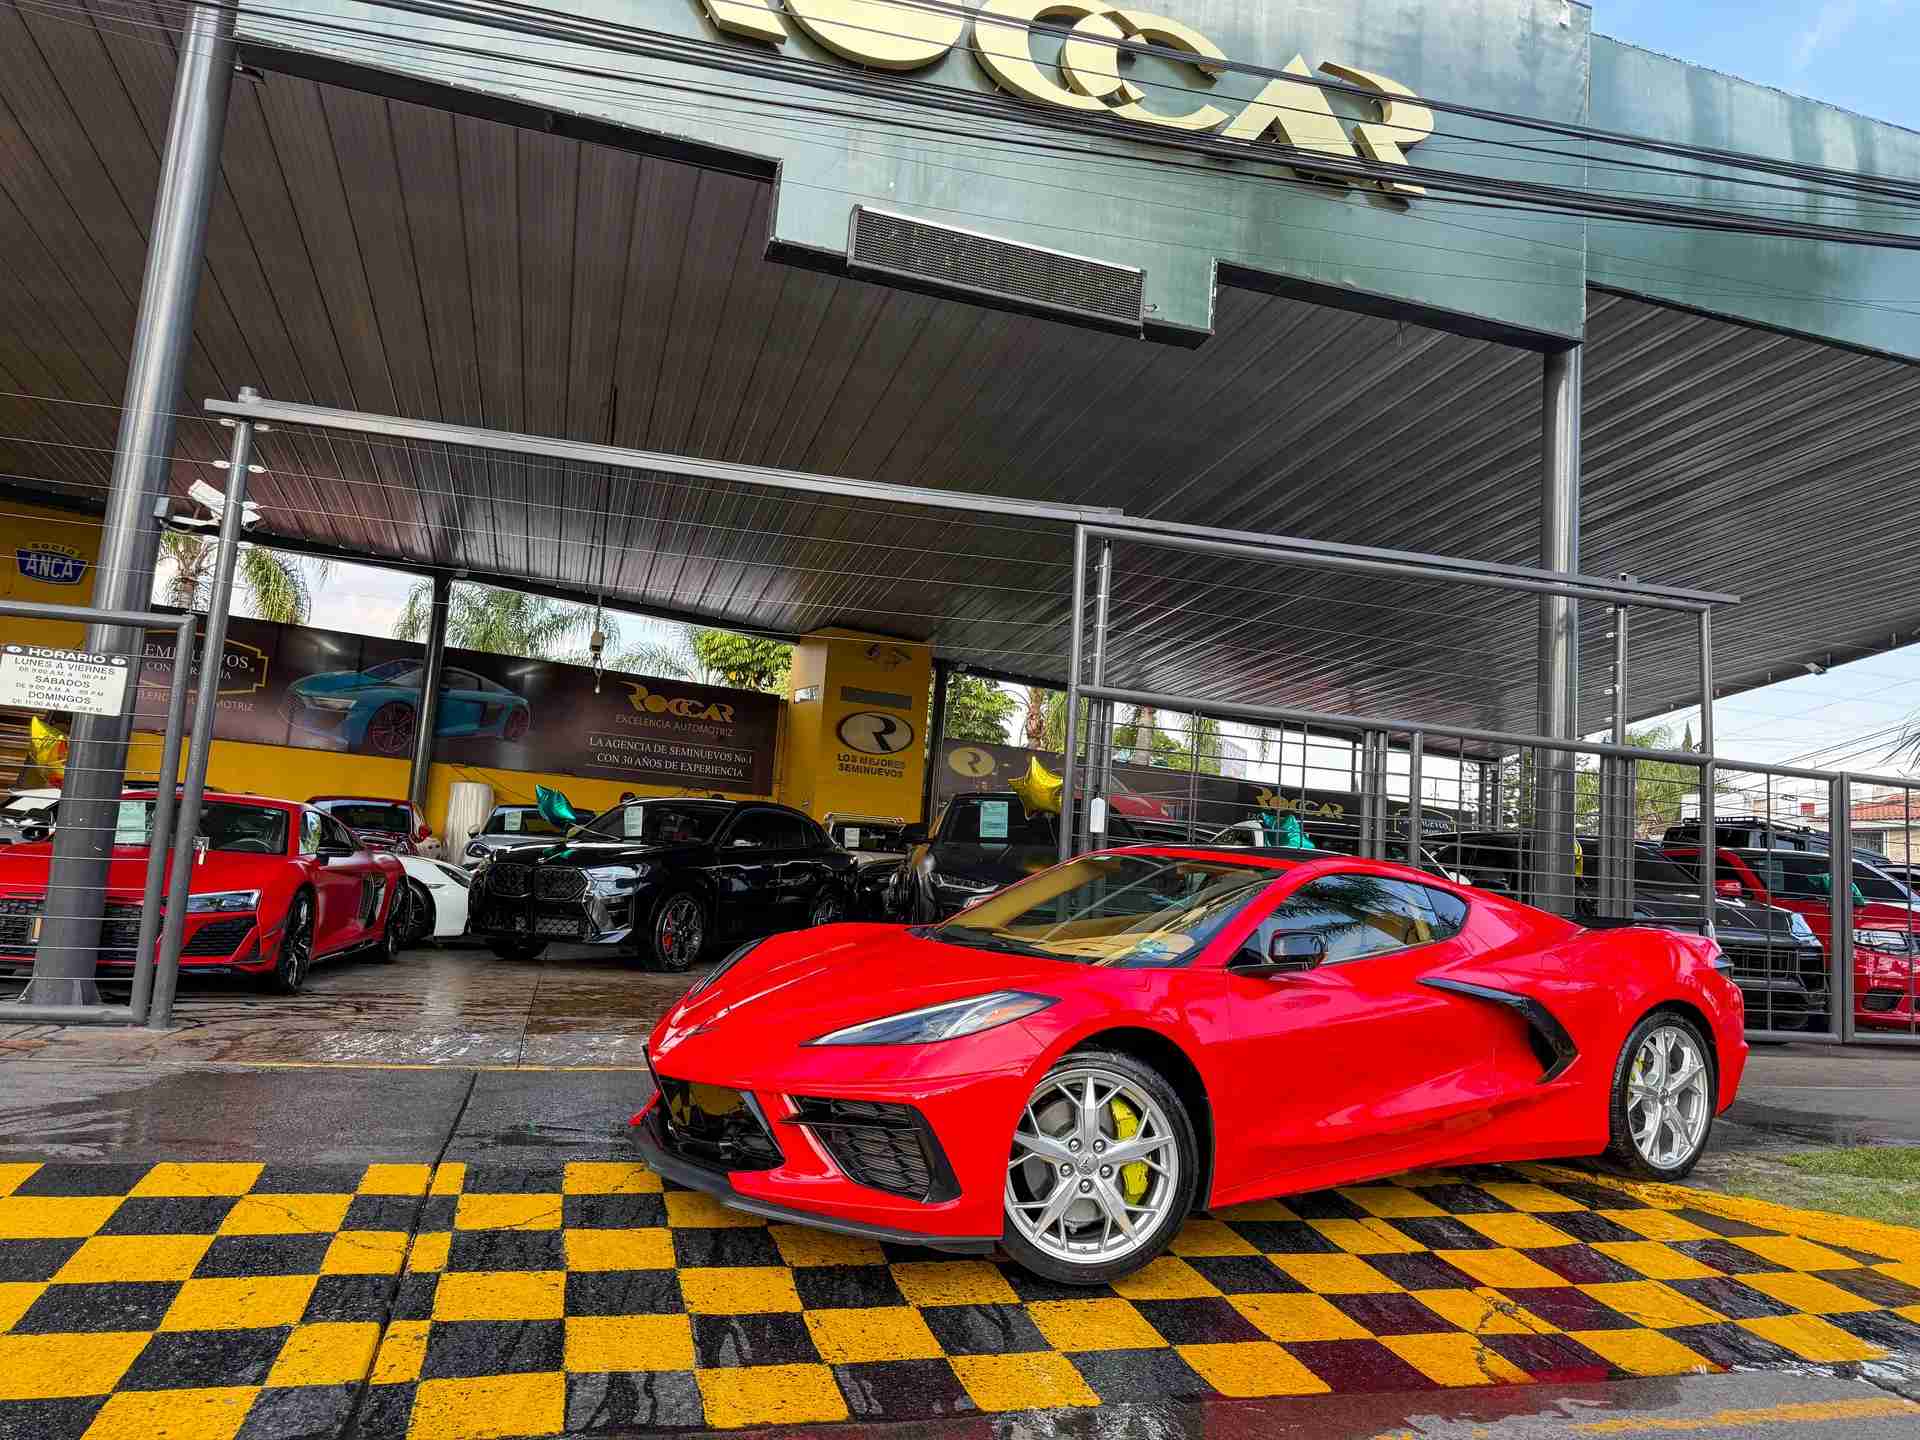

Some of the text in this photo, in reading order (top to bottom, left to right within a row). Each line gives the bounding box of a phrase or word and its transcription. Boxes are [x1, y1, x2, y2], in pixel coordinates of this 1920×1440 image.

[700, 0, 1436, 198] OCCAR
[25, 553, 73, 578] ANCA
[29, 648, 106, 664] HORARIO
[14, 656, 115, 675] LUNES A VIERNES
[35, 675, 91, 689] SABADOS
[28, 690, 91, 705] DOMINGOS
[618, 681, 736, 722] ROCCAR
[615, 713, 672, 729] EXCELENCIA
[590, 736, 604, 748] LA
[605, 738, 651, 753] AGENCIA
[653, 744, 668, 754] DE
[669, 745, 732, 762] SEMINUEVOS
[597, 752, 619, 764] CON
[634, 755, 662, 769] AÑOS
[664, 760, 679, 770] DE
[680, 762, 744, 778] EXPERIENCIA
[838, 753, 906, 769] LOS MEJORES
[838, 763, 904, 777] SEMINUEVOS
